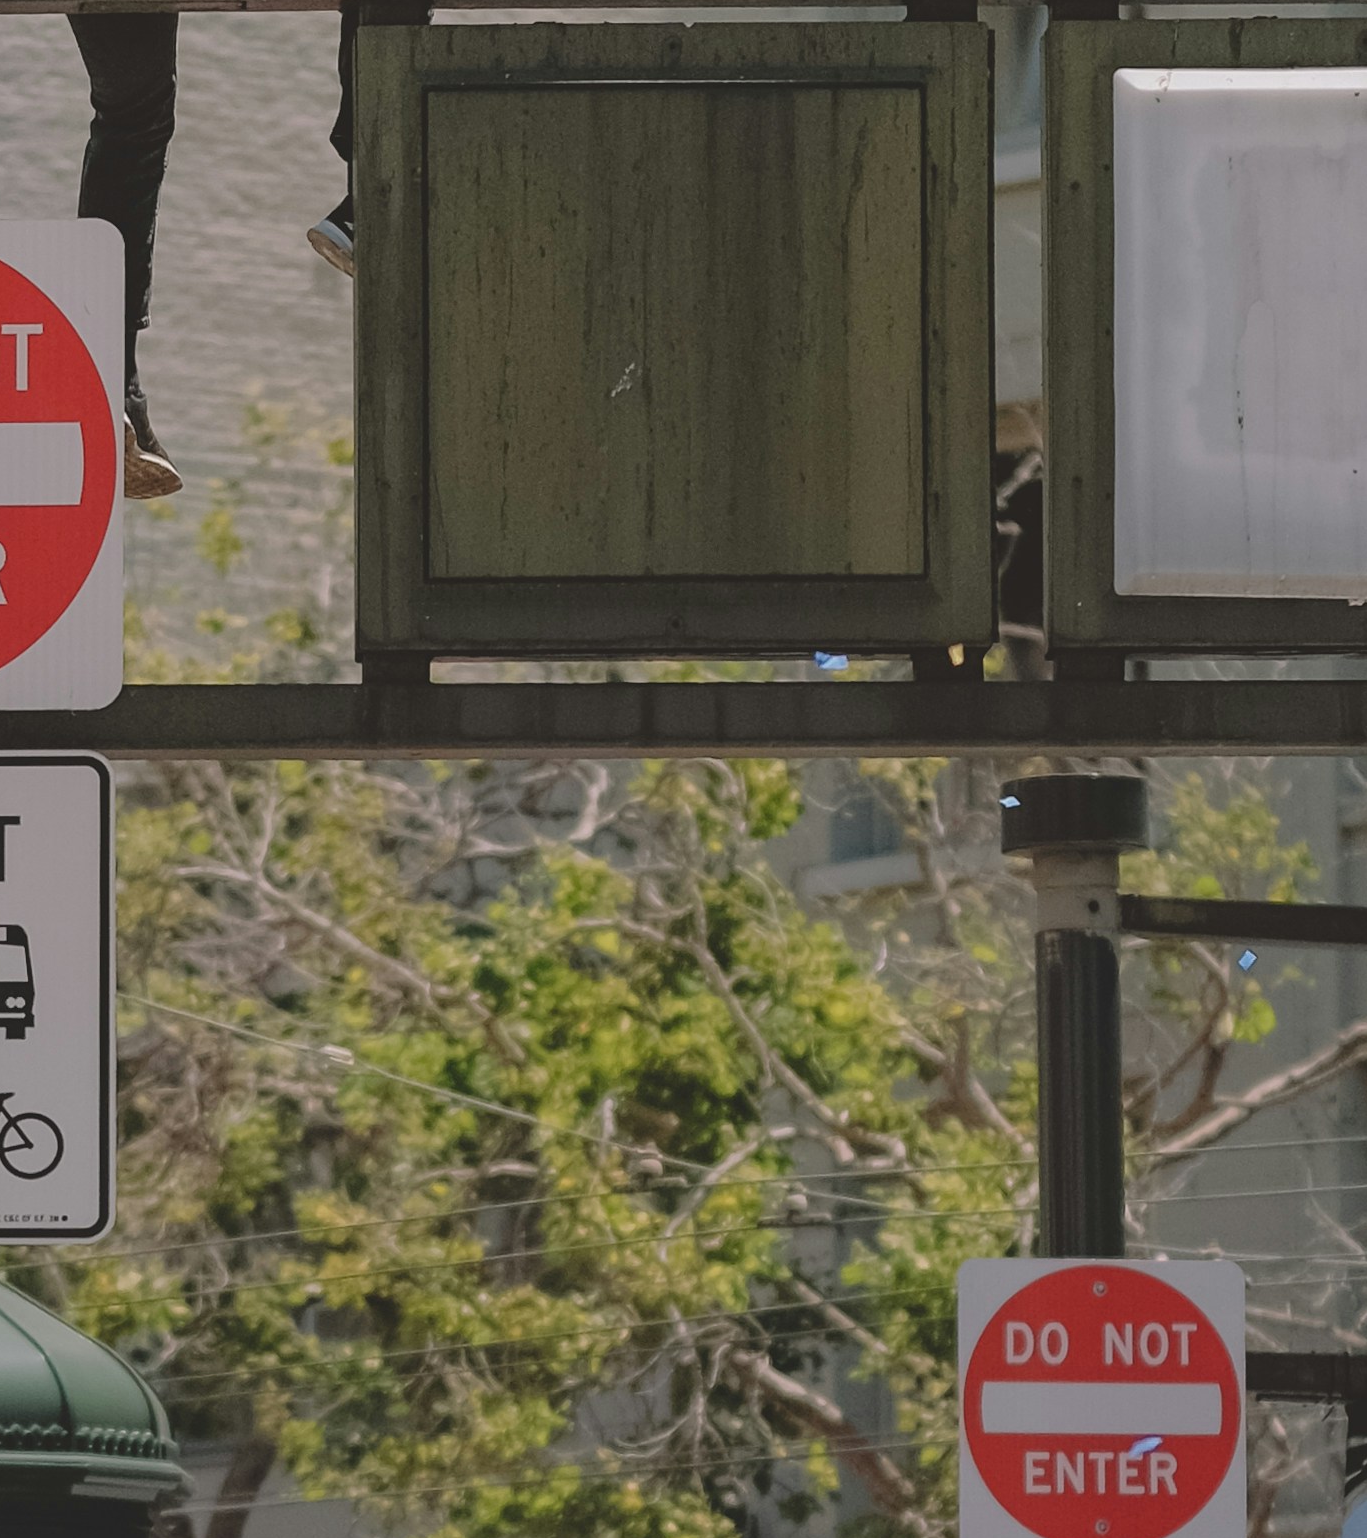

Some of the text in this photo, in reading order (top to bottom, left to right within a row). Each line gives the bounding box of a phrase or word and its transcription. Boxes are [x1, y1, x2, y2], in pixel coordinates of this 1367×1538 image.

[1005, 1321, 1198, 1367] DO NOT
[1024, 1451, 1179, 1496] ENTER
